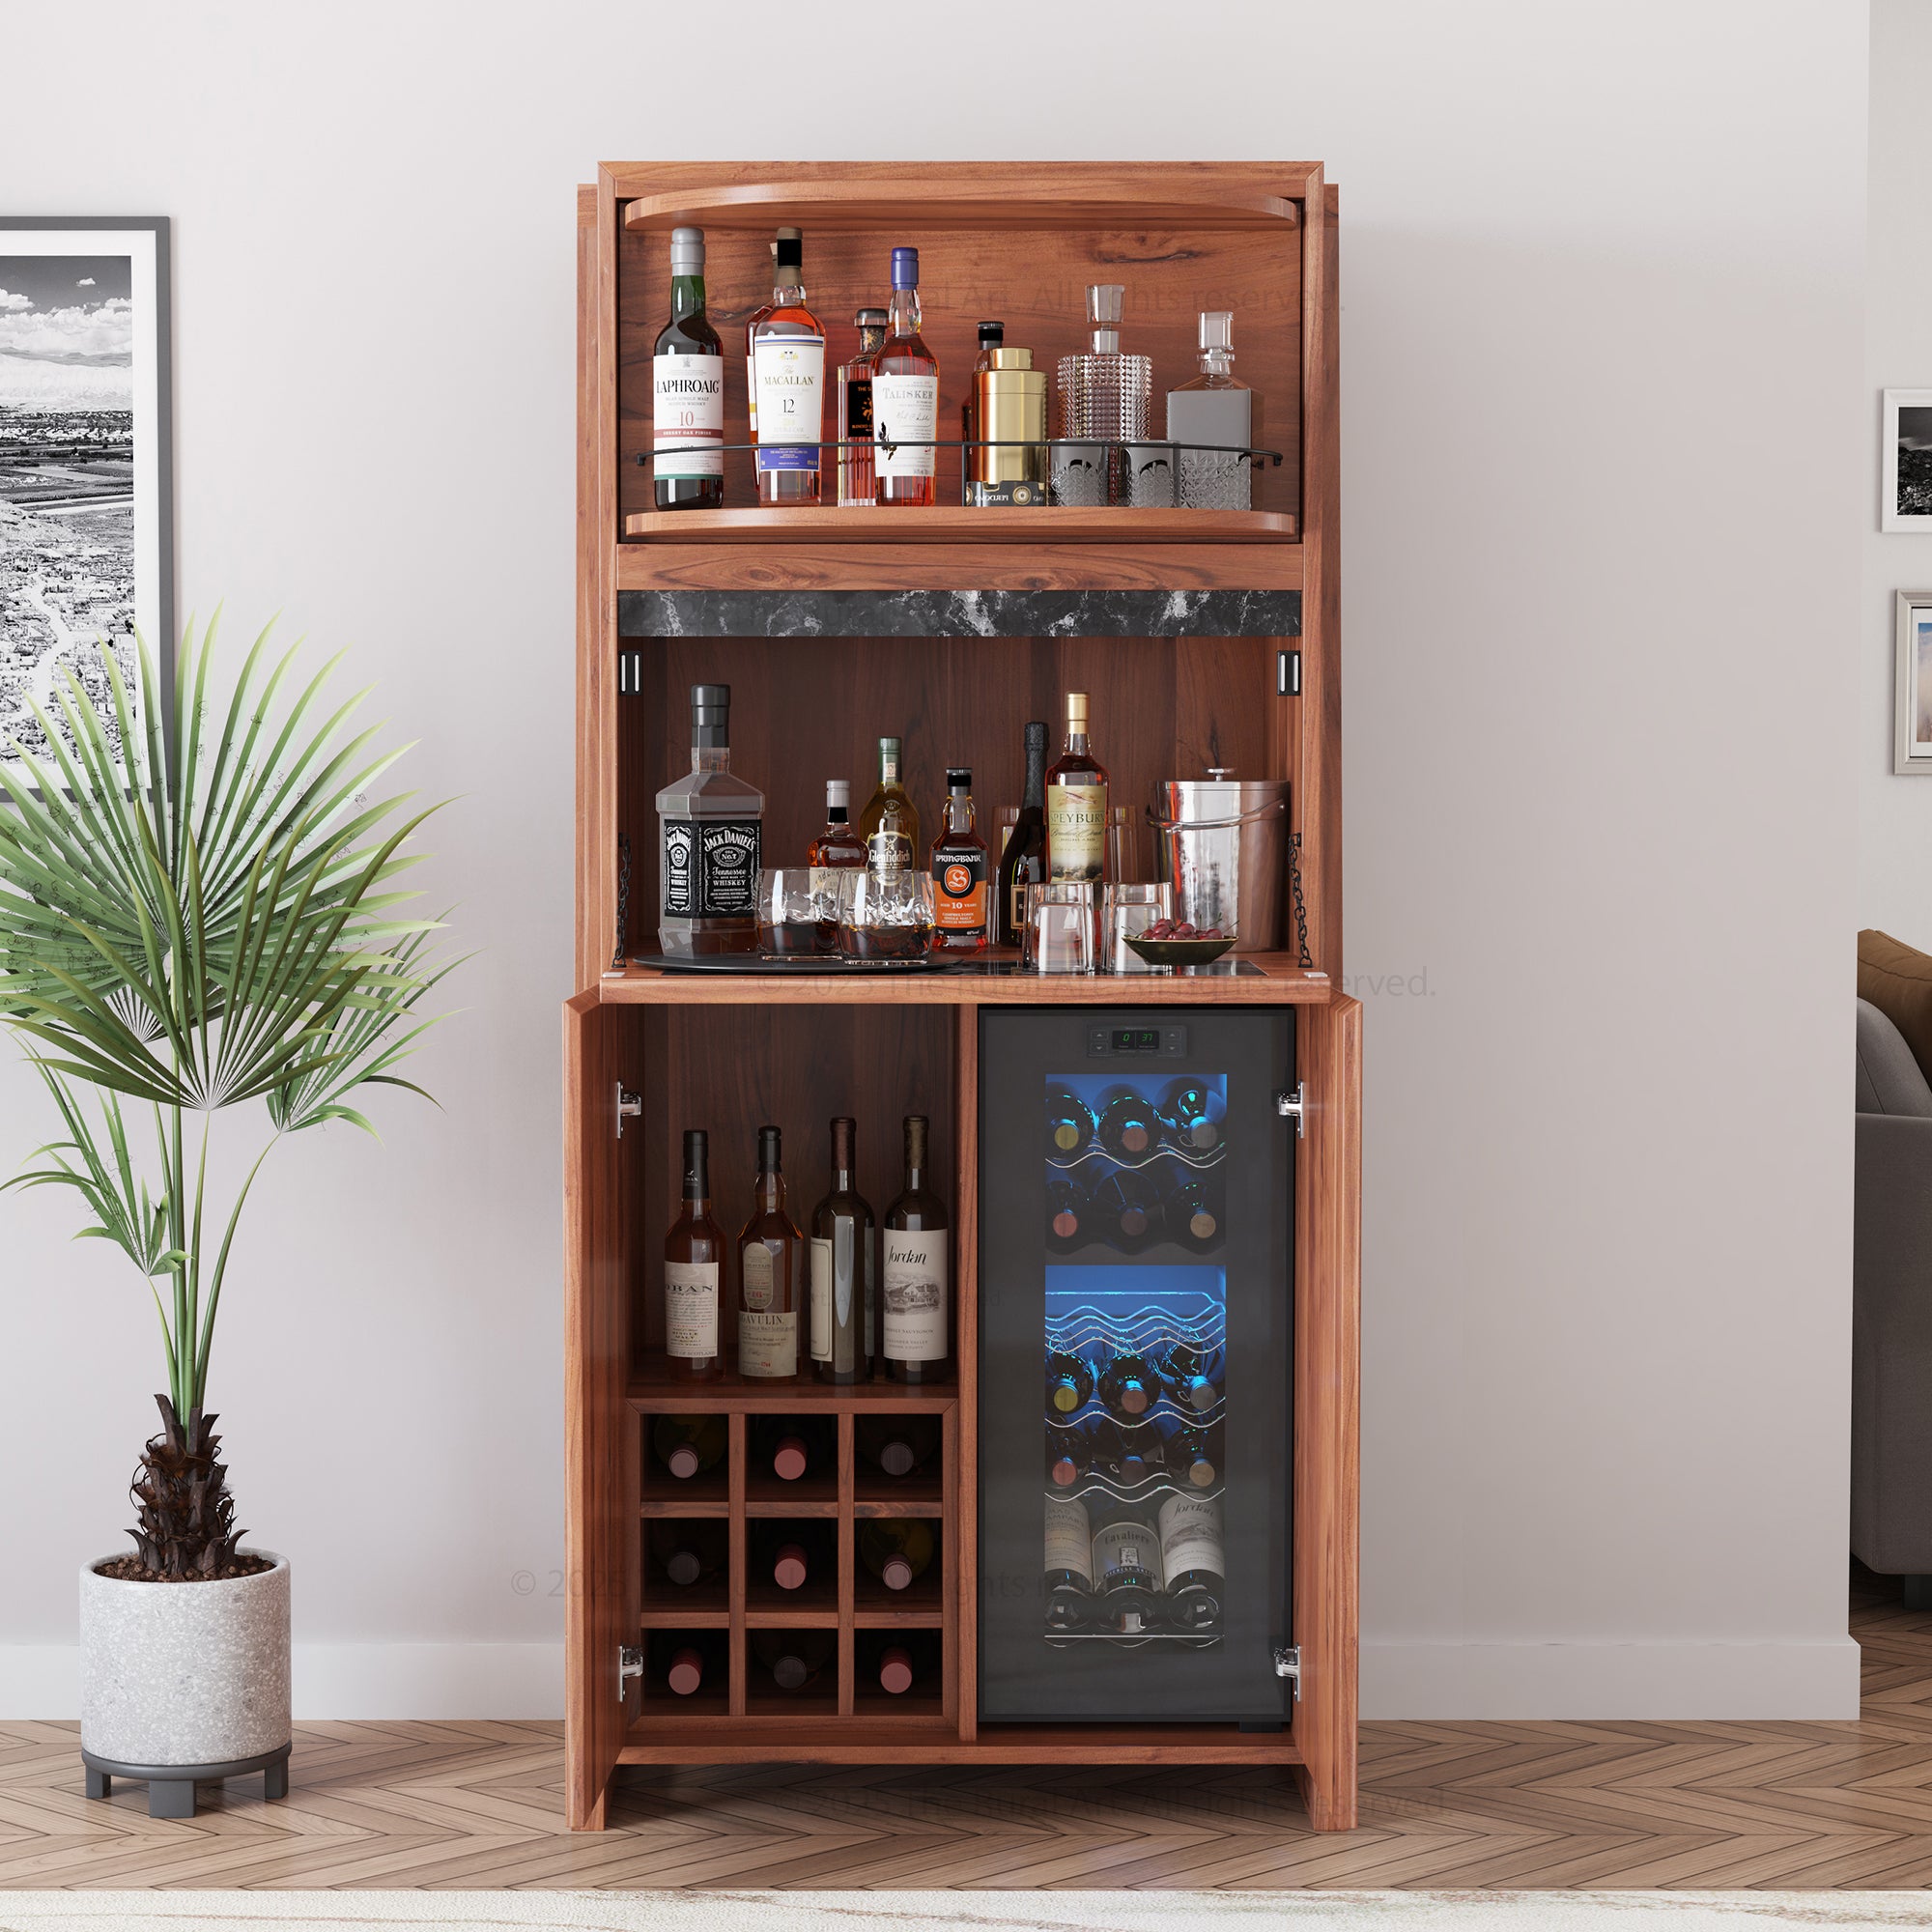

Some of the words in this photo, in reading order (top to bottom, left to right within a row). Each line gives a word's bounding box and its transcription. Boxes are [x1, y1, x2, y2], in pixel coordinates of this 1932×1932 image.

[764, 377, 814, 385] MACALLAN
[882, 387, 933, 400] TALISKER
[783, 398, 795, 413] 12
[679, 411, 695, 427] 10
[703, 835, 724, 852] JACK
[724, 829, 756, 851] DANIEL'S
[869, 849, 911, 863] Glenfiddich
[712, 867, 747, 876] Tennessee
[1142, 1033, 1152, 1042] 37
[886, 1245, 926, 1265] Jordan
